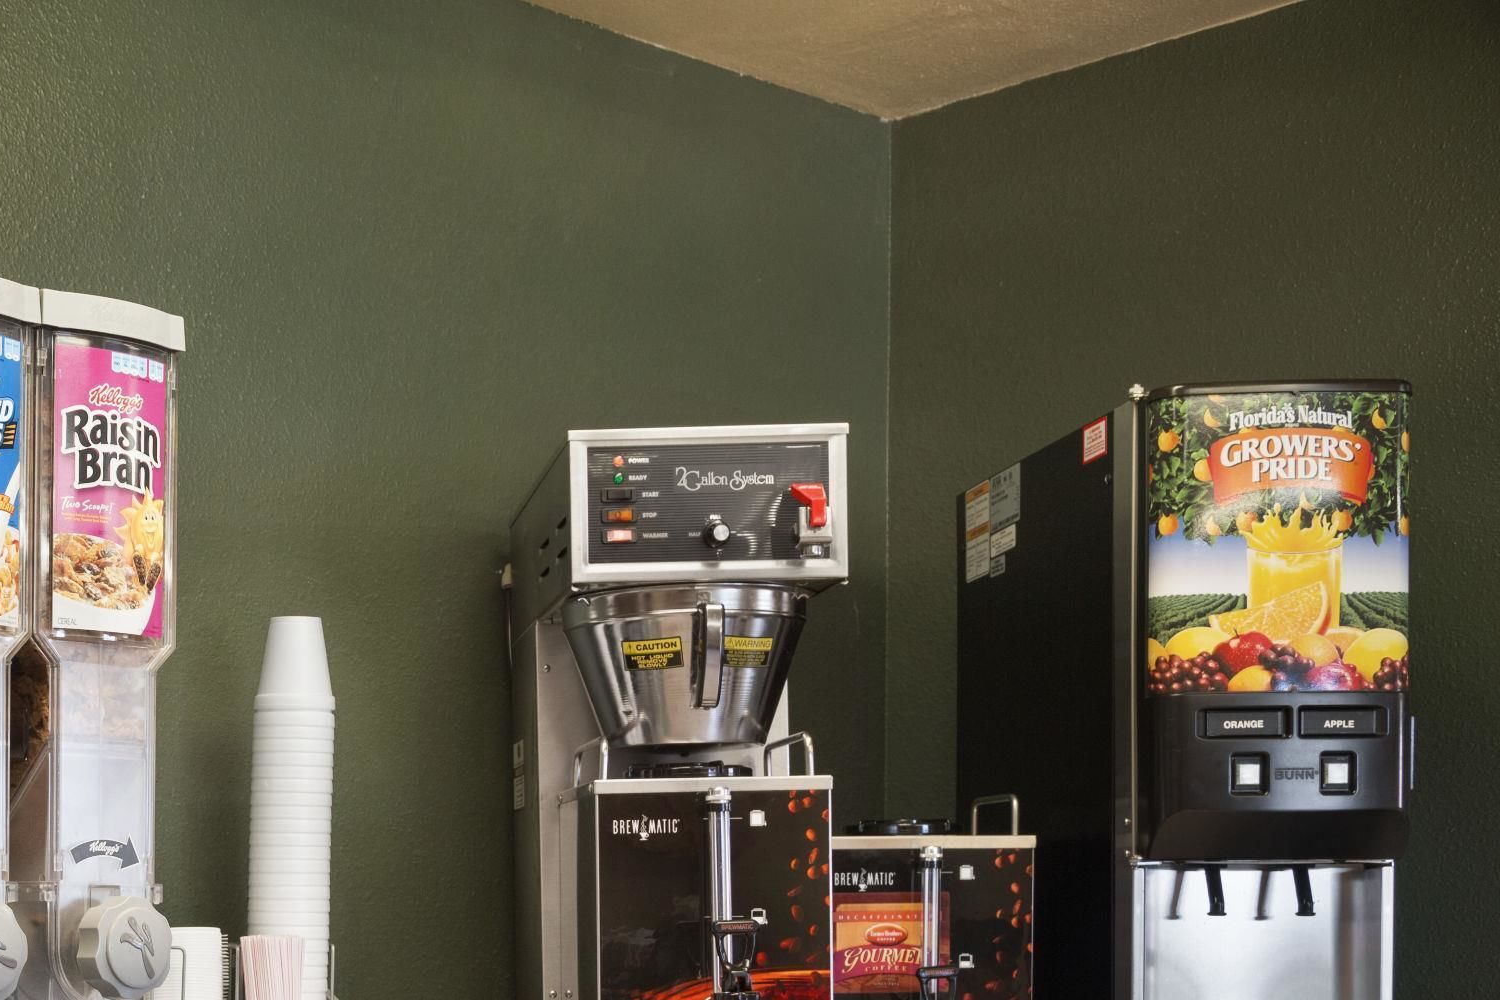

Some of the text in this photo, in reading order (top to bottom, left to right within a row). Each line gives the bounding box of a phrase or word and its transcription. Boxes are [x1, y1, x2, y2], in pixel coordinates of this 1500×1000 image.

[90, 384, 143, 413] Kellogg's
[1229, 403, 1353, 432] Florida's Natural
[65, 408, 159, 464] Raisin
[1220, 434, 1362, 468] GROWERS'
[77, 447, 152, 490] Bran
[1251, 457, 1333, 483] PRIDE
[684, 470, 729, 491] Gallon
[729, 469, 775, 491] System
[635, 641, 677, 651] CAUTION
[734, 640, 771, 649] WARNING
[1223, 720, 1264, 729] ORANGE
[1324, 720, 1355, 729] APPLE
[88, 840, 120, 856] Kellogg's
[838, 913, 919, 921] DECAFFEINAT
[720, 923, 754, 931] BREWMATIC
[864, 964, 908, 972] COFFEE
